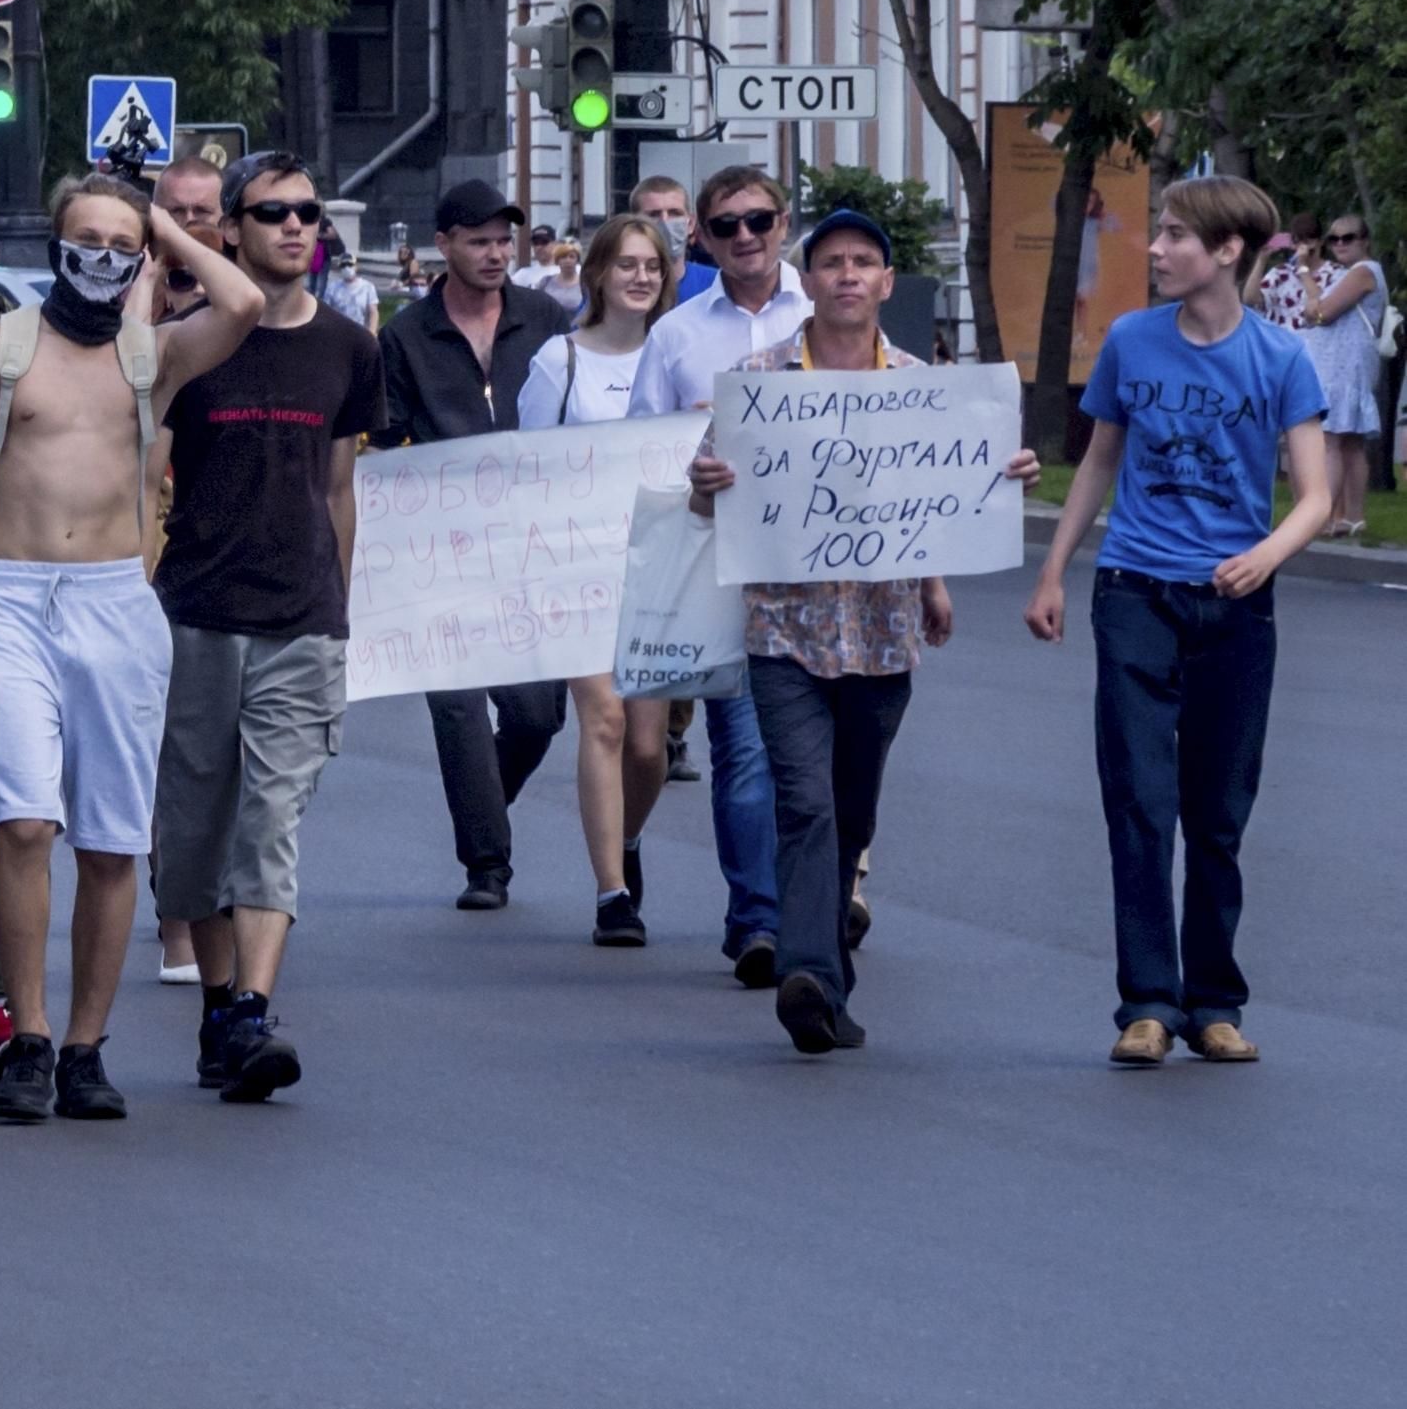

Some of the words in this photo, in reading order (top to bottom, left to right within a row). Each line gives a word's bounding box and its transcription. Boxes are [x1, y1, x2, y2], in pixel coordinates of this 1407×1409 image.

[738, 75, 855, 111] СТОП
[1124, 379, 1269, 430] DUBAI
[800, 520, 928, 573] 100%
[628, 636, 705, 664] #янесу
